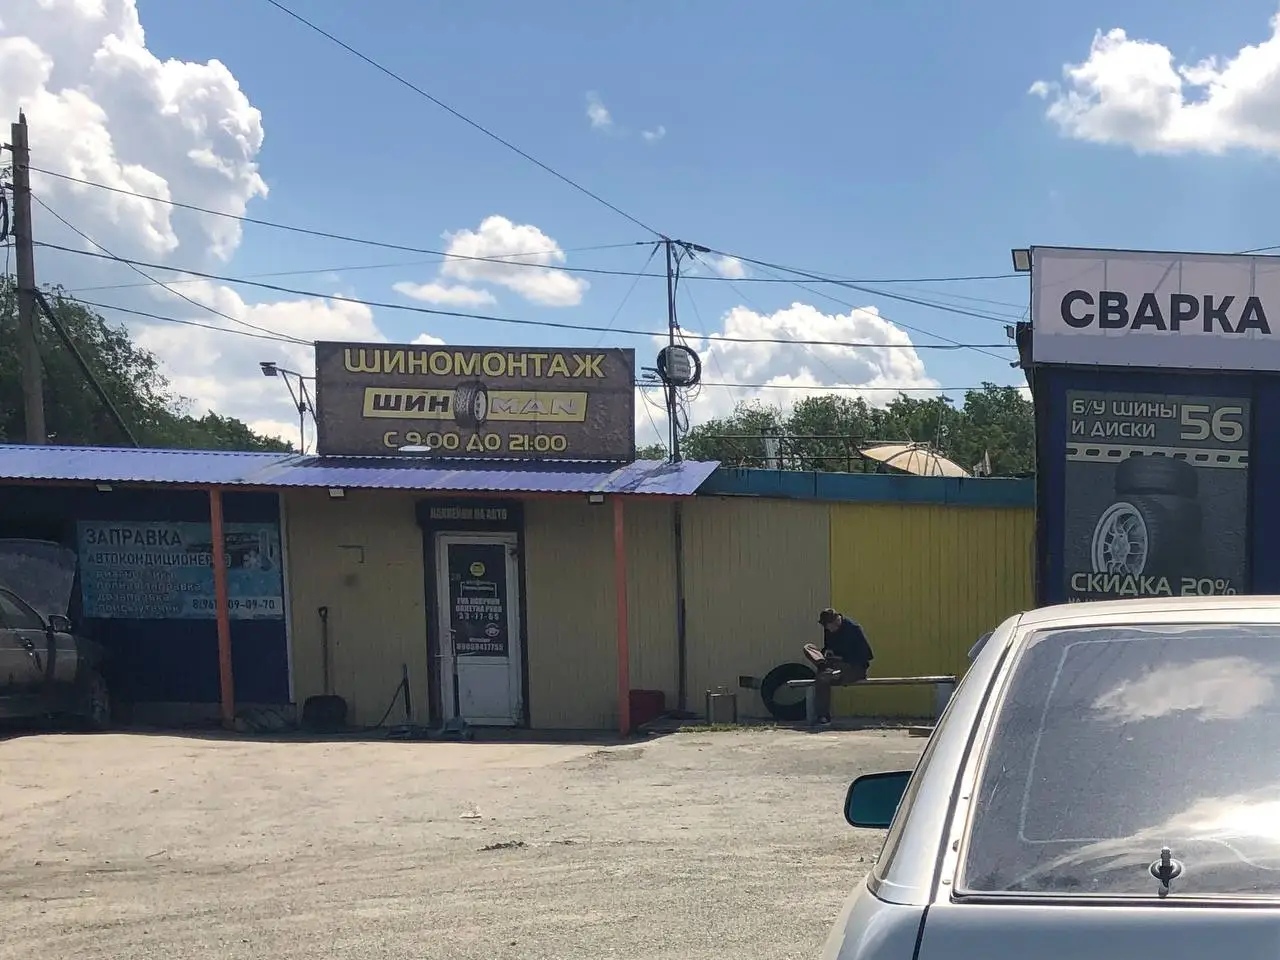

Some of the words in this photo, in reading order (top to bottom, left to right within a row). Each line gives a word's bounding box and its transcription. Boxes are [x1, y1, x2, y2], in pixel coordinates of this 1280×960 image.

[1060, 289, 1271, 334] СВАРКА
[344, 348, 605, 378] ШИНОМОНТАЖ
[1072, 400, 1106, 415] Б/У
[1112, 402, 1177, 418] ШИНЫ
[1072, 420, 1085, 435] И
[1091, 421, 1155, 438] ДИСКИ
[1180, 405, 1243, 442] 56
[384, 432, 398, 448] С
[466, 433, 501, 452] ДО
[508, 434, 568, 451] 21:00
[86, 528, 182, 546] ЗАПРАВКА
[1071, 573, 1172, 596] СКИДКА
[1180, 577, 1236, 596] 20%
